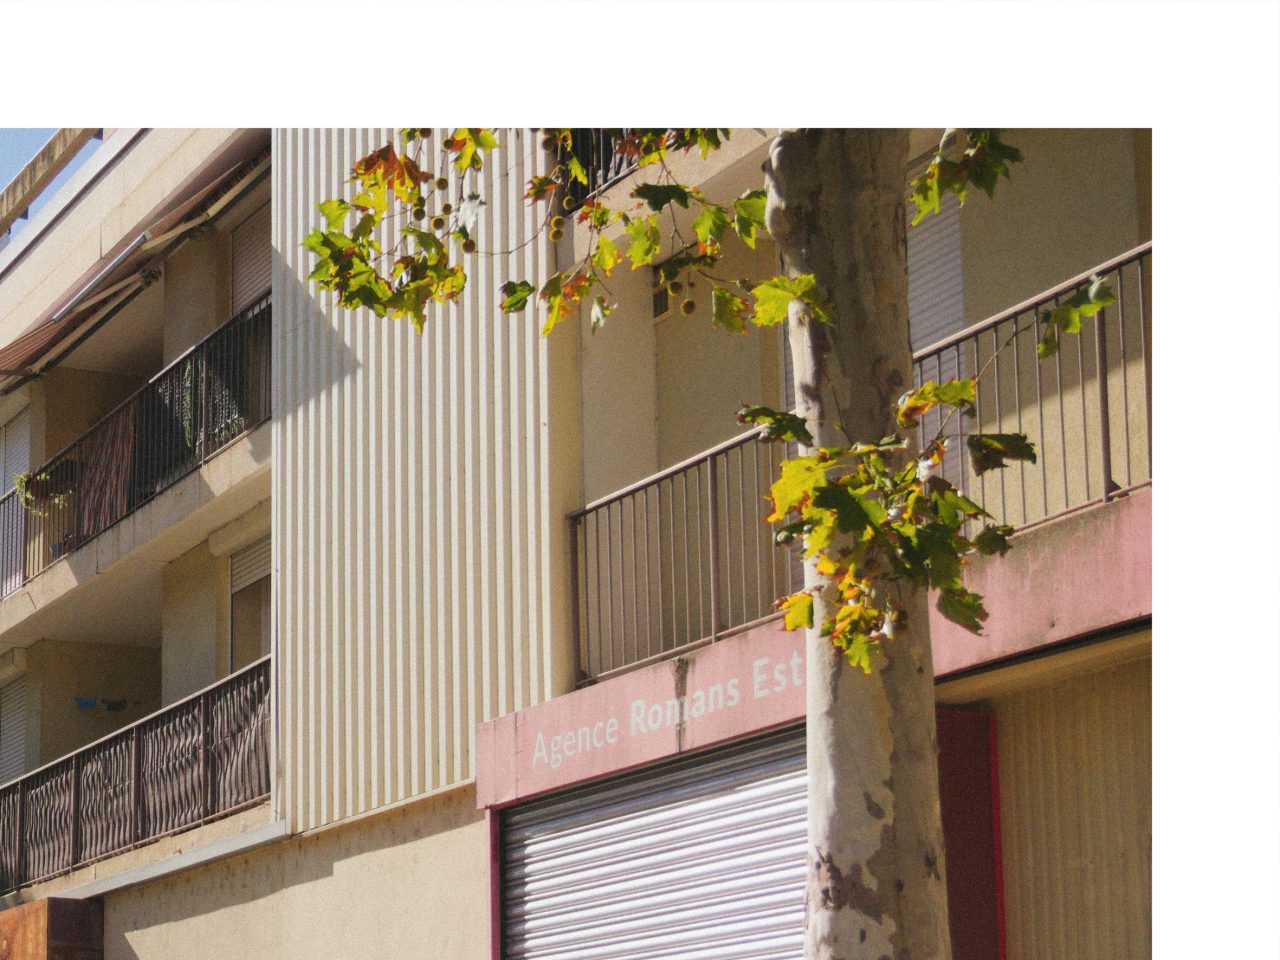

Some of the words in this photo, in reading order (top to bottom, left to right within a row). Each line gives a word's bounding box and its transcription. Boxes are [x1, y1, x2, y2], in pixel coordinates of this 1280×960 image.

[530, 717, 619, 769] Agence
[630, 677, 741, 737] Romans
[752, 650, 803, 698] Est
